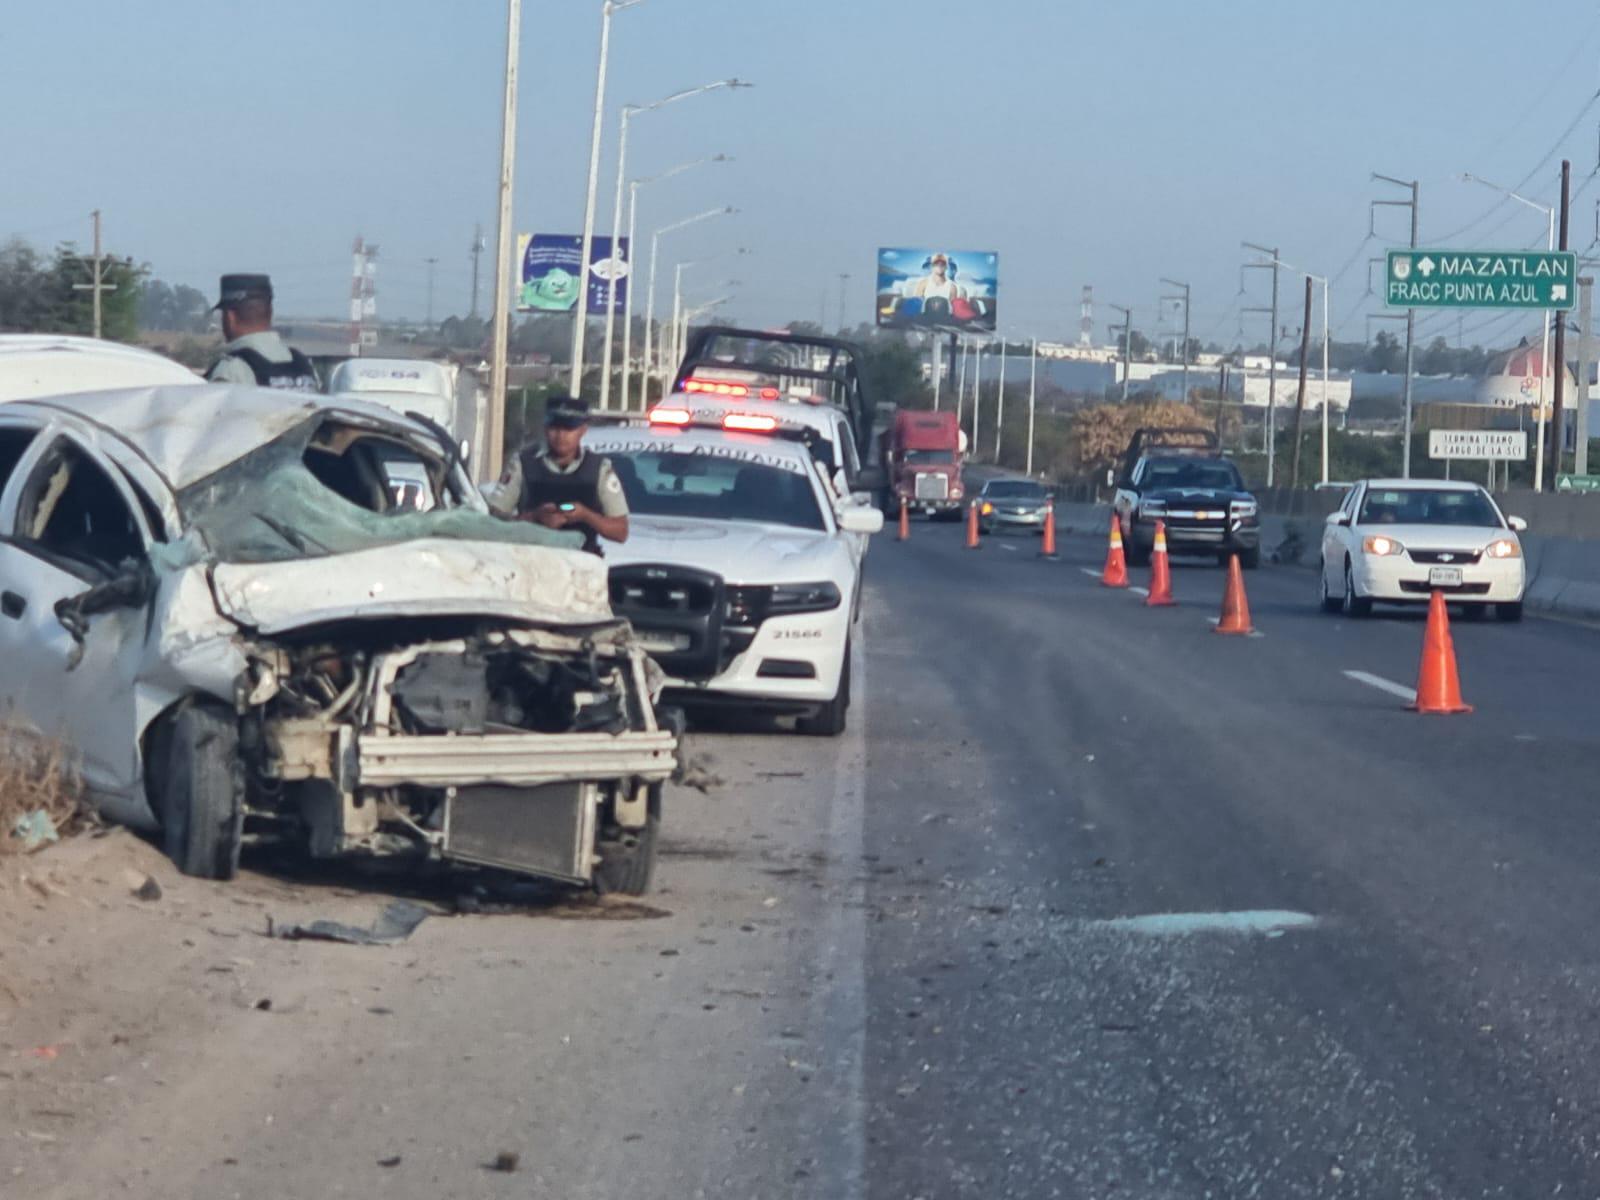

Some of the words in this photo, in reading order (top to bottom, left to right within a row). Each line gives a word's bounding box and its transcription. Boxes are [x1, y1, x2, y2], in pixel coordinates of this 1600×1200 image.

[1440, 257, 1568, 277] MAZATLAN
[1389, 282, 1440, 300] FRACC
[1444, 283, 1495, 301] PUNTA
[1500, 284, 1539, 302] AZUL
